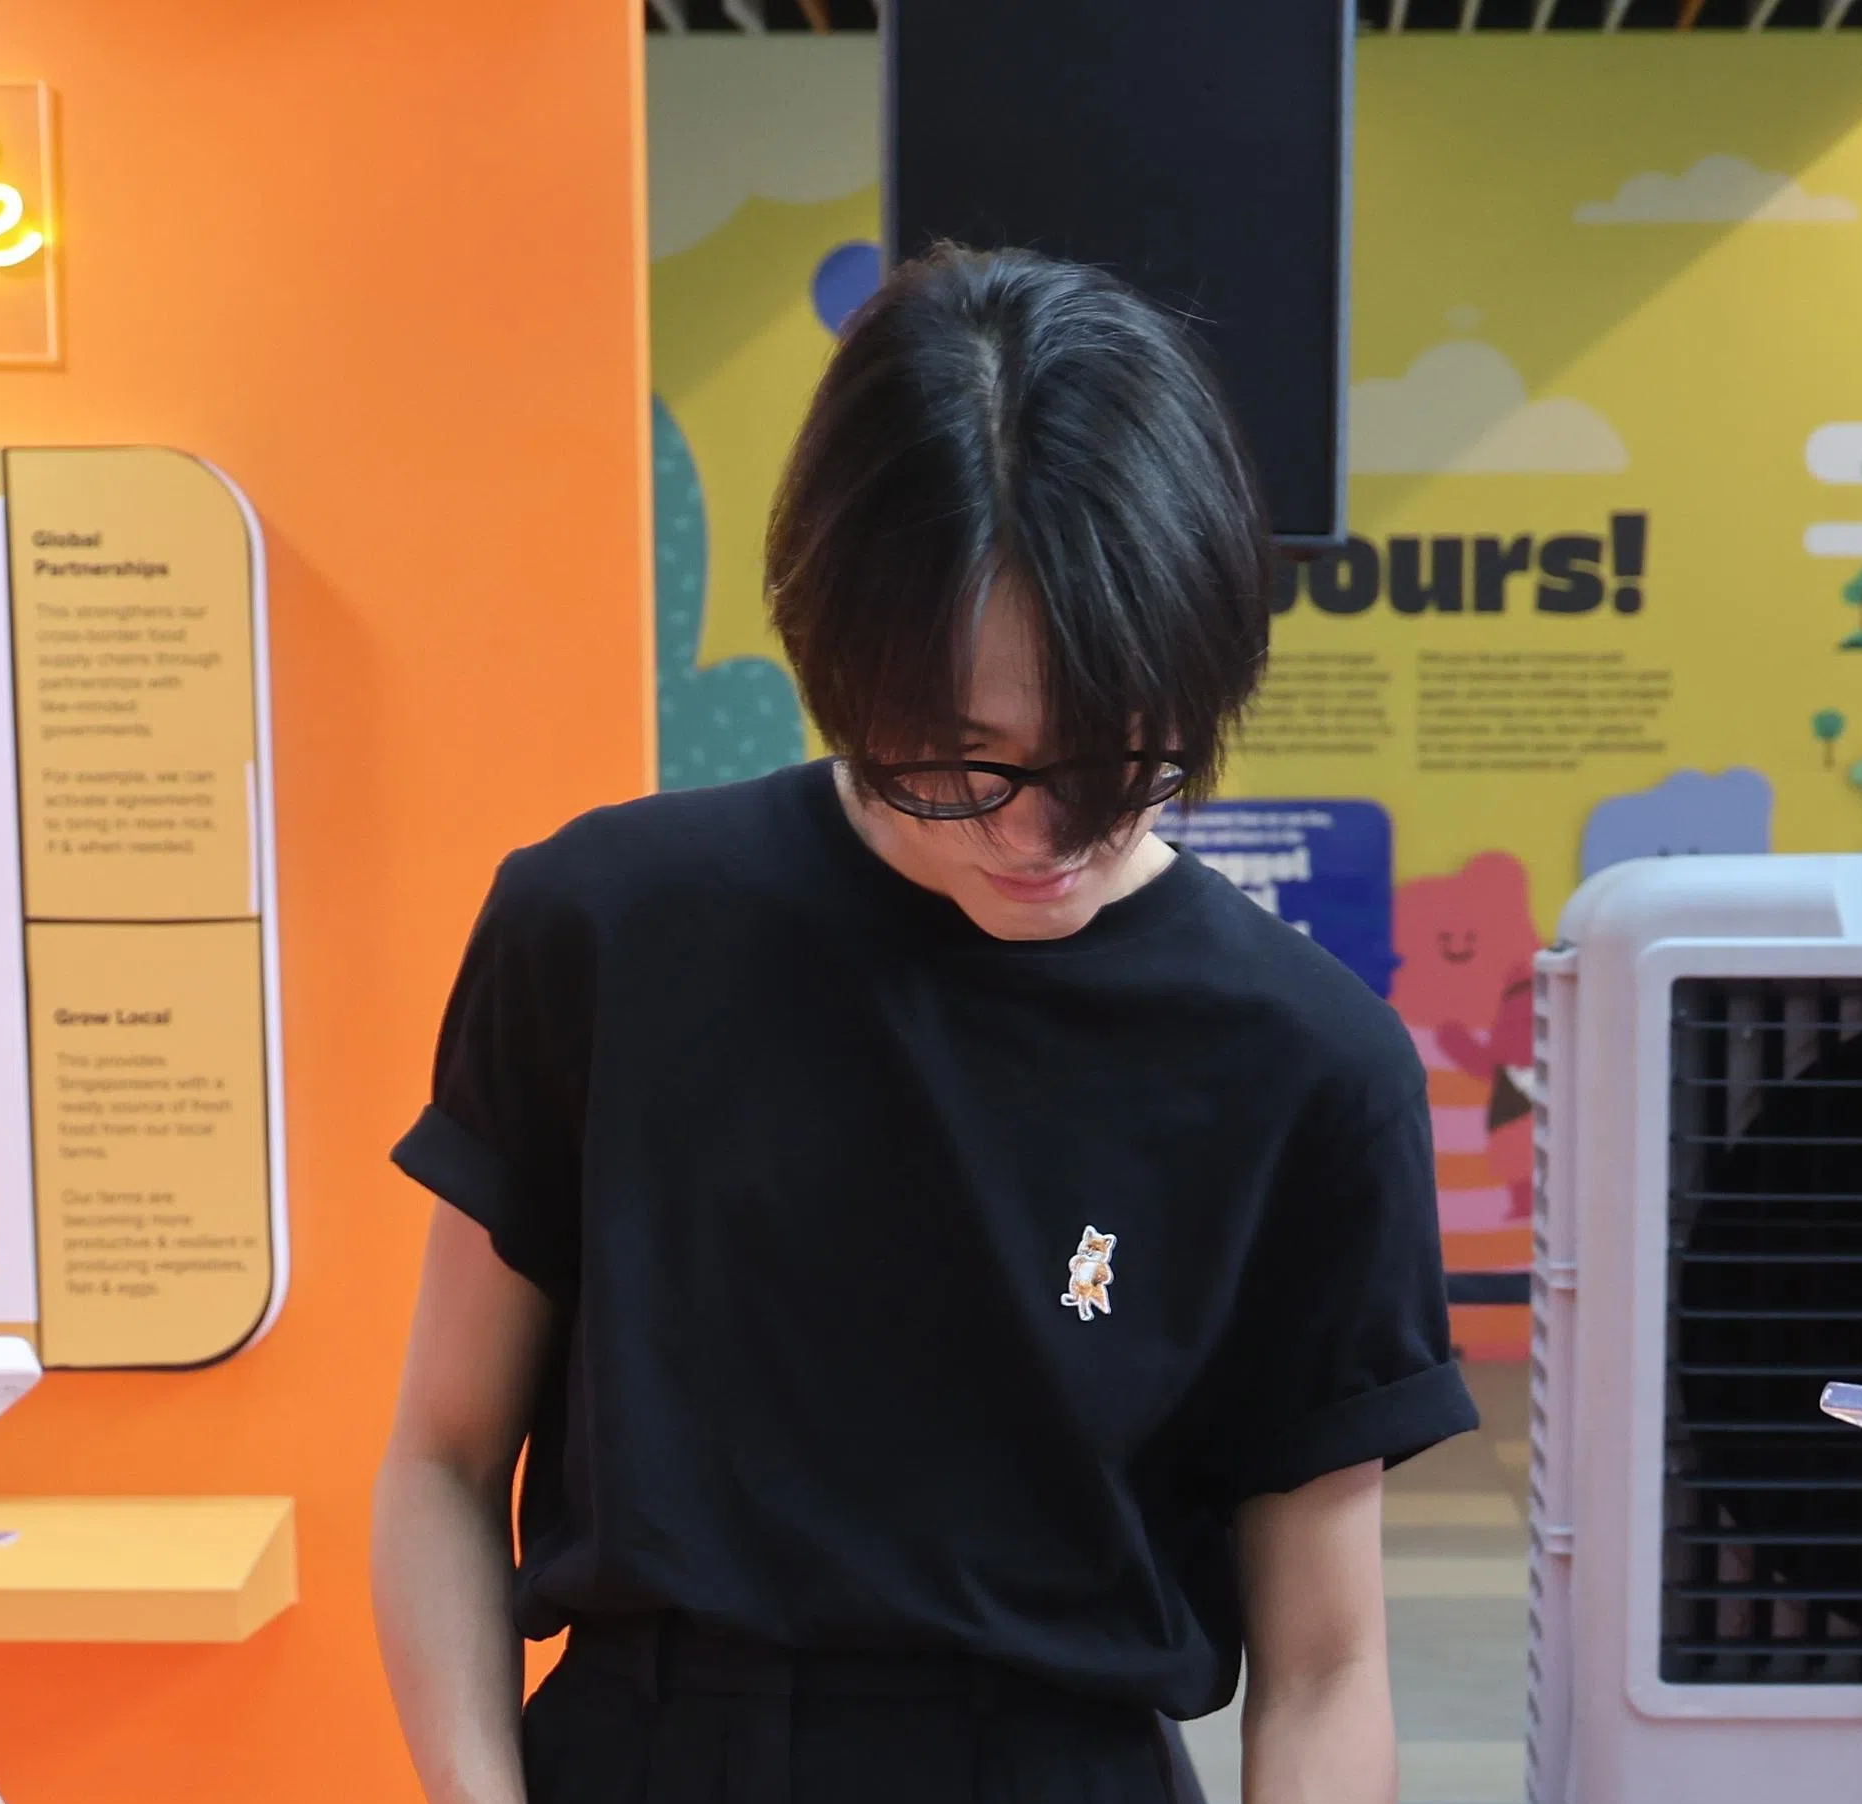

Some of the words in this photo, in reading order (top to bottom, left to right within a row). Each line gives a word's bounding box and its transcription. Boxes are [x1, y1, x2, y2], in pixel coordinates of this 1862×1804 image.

[33, 530, 101, 548] Global
[34, 559, 169, 577] Partnerships
[37, 604, 69, 618] This
[76, 604, 173, 620] strengthens
[180, 606, 207, 618] our
[36, 628, 141, 641] cross-border
[148, 628, 185, 641] food
[37, 651, 90, 668] supply
[97, 651, 149, 665] chains
[155, 651, 221, 668] through
[39, 675, 141, 691] partnerships
[148, 675, 182, 688] with
[40, 699, 137, 713] like-minded
[42, 724, 151, 739] governments.
[42, 770, 68, 783] For
[75, 770, 148, 785] example,
[156, 773, 178, 784] we
[184, 773, 215, 784] can
[44, 794, 107, 807] activate
[113, 794, 213, 810] agreements
[54, 1009, 109, 1026] Grow
[116, 1009, 171, 1026] Local
[57, 1053, 89, 1067] This
[94, 1053, 166, 1070] provides
[57, 1076, 170, 1092] Singaporeans
[176, 1076, 208, 1090] with
[215, 1079, 224, 1090] a
[60, 1100, 105, 1115] ready
[112, 1102, 165, 1114] source
[172, 1100, 187, 1113] of
[191, 1099, 232, 1113] fresh
[60, 1122, 97, 1136] food
[103, 1122, 137, 1136] from
[146, 1125, 170, 1136] our
[176, 1122, 214, 1136] local
[62, 1190, 91, 1204] Our
[96, 1190, 142, 1204] farms
[149, 1193, 174, 1204] are
[63, 1213, 144, 1229] becoming
[152, 1214, 193, 1226] more
